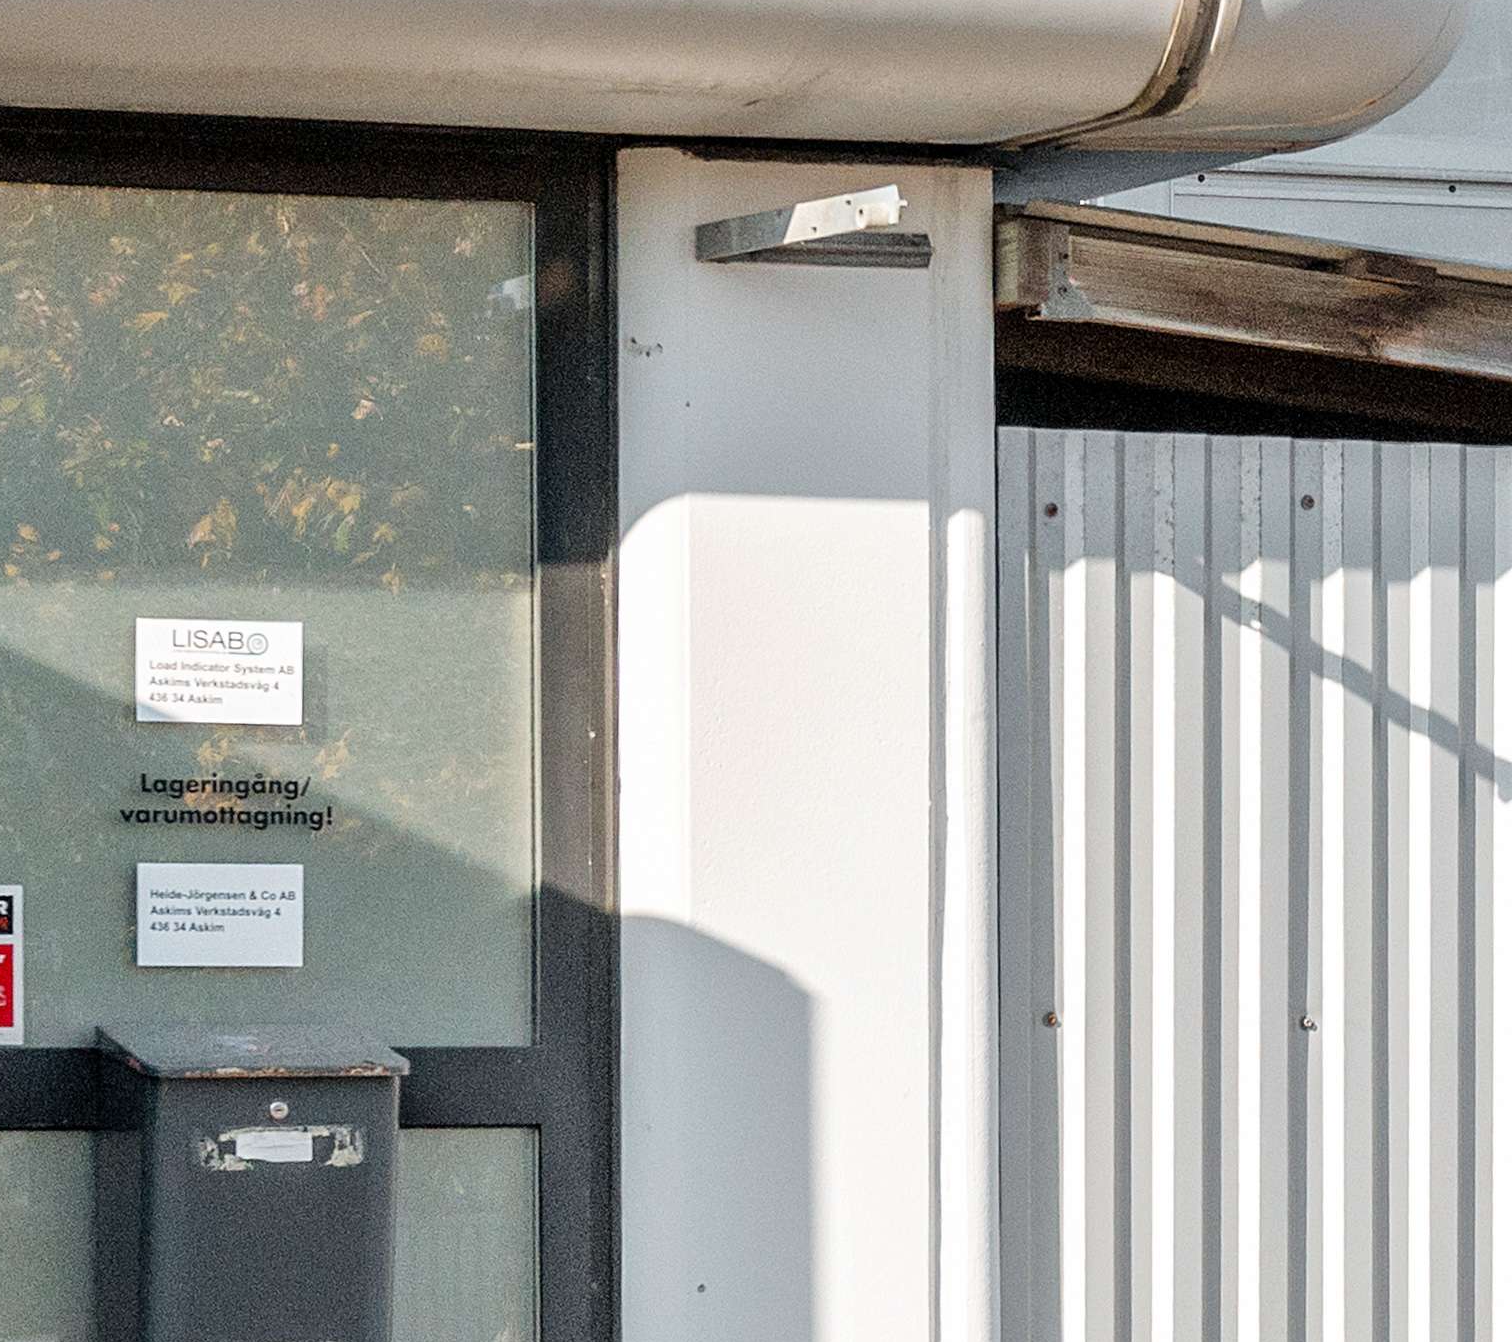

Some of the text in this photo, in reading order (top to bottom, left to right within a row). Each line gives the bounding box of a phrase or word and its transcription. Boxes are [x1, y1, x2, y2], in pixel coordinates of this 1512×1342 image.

[149, 660, 295, 676] Load Indicator System AB
[149, 676, 191, 688] Askims
[273, 681, 280, 690] 4
[149, 693, 223, 704] 436 34 Askim
[141, 772, 311, 800] Lageringång/
[120, 805, 333, 830] varumottagning!
[249, 890, 257, 900] &
[260, 891, 276, 901] Co
[279, 891, 296, 901] AB
[149, 905, 192, 916] Askims
[274, 908, 281, 917] 4
[149, 921, 225, 932] 436 34 Askim
